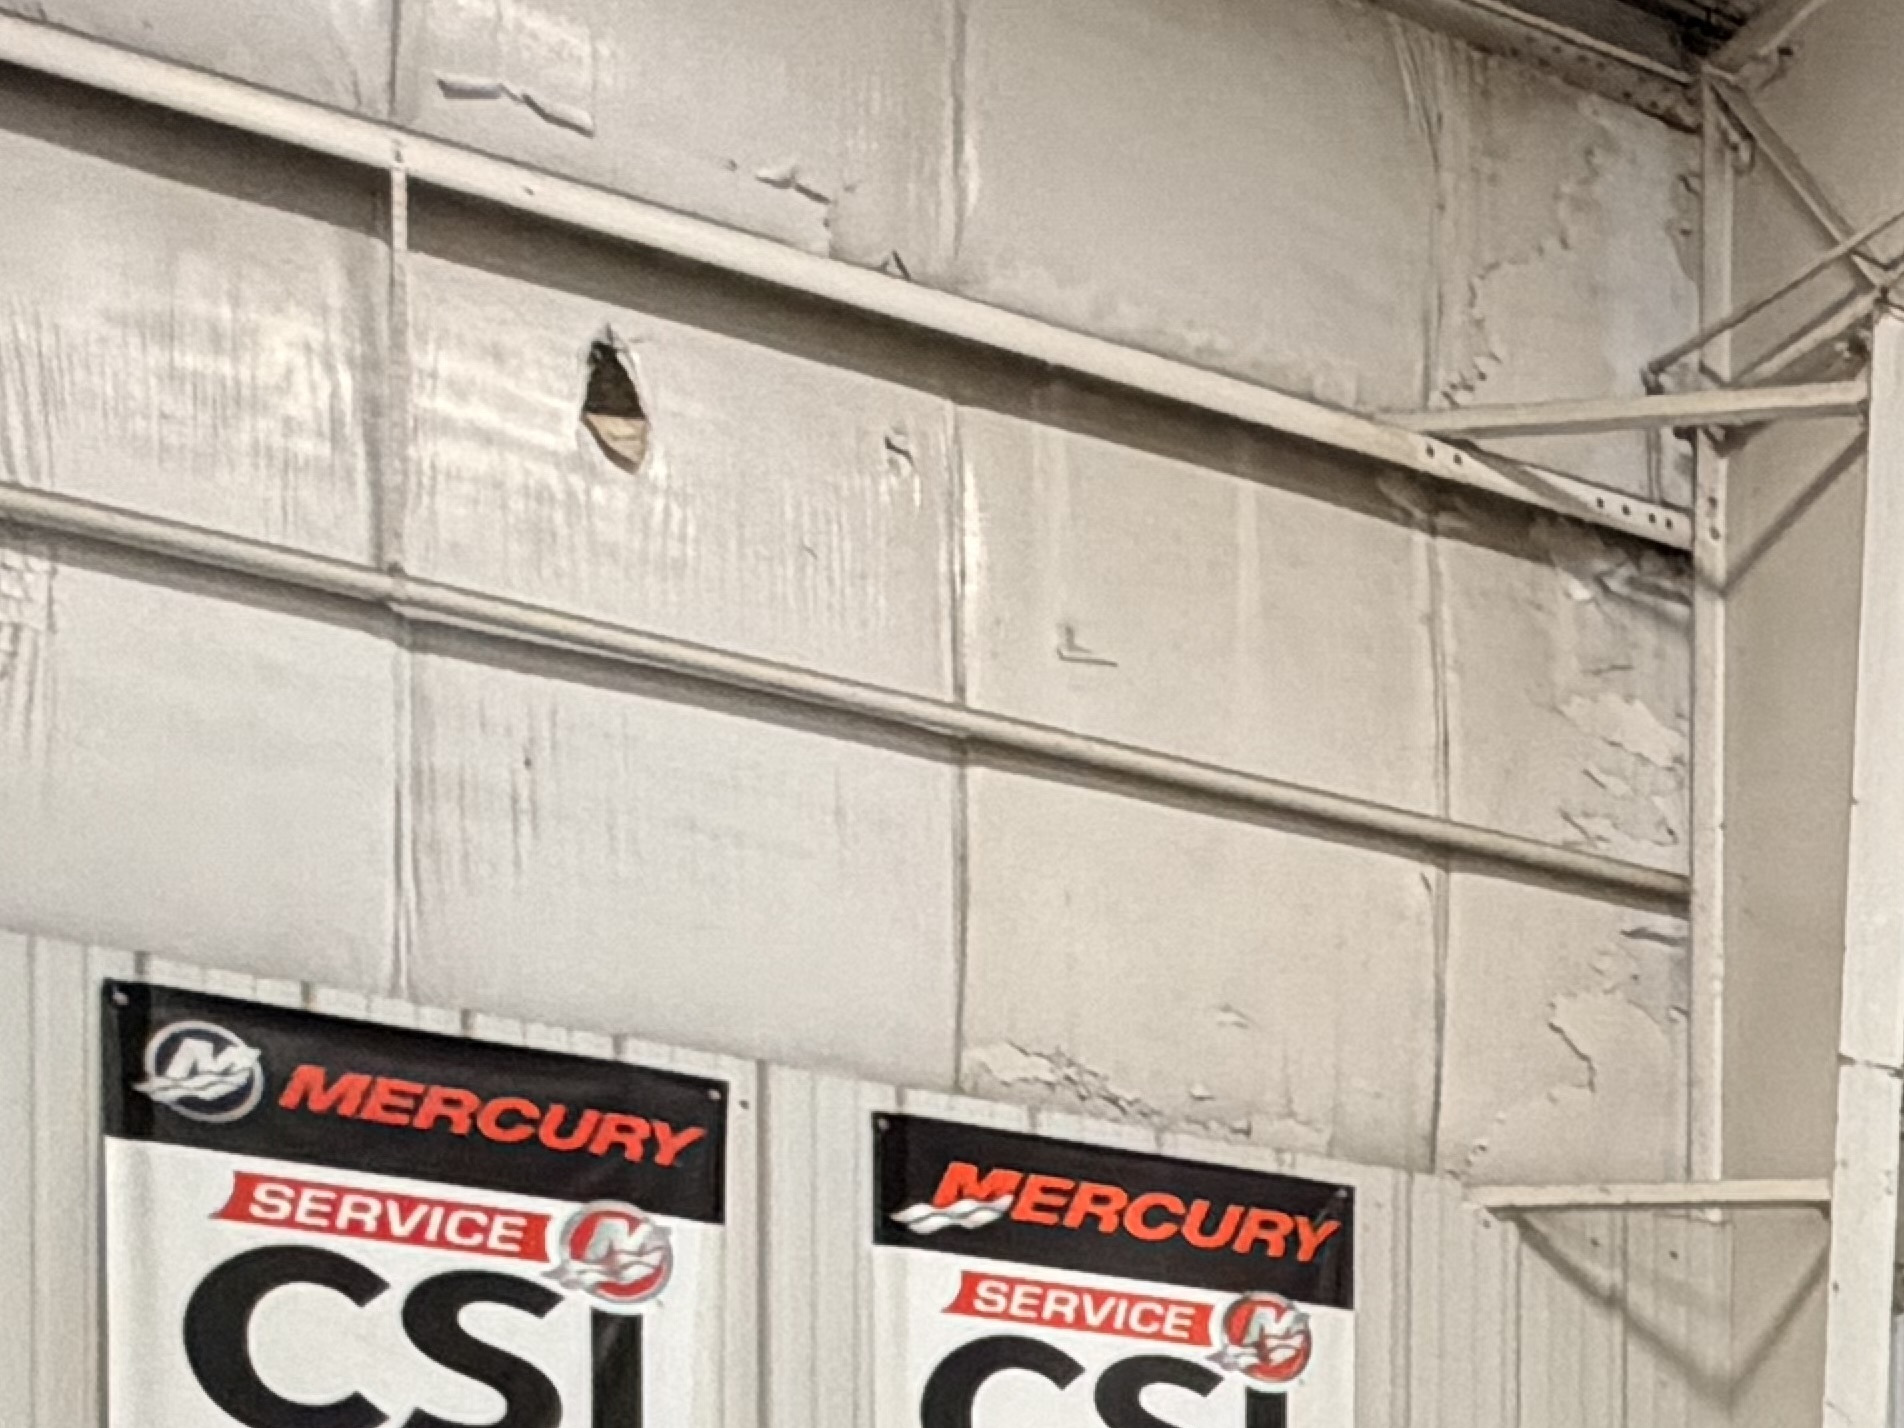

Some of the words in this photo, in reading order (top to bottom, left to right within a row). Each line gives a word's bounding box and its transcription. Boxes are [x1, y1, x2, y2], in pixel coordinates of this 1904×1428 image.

[281, 1065, 705, 1165] MERCURY
[250, 1182, 526, 1252] SERVICE
[933, 1162, 1338, 1262] MERCURY
[973, 1283, 1194, 1337] SERVICE
